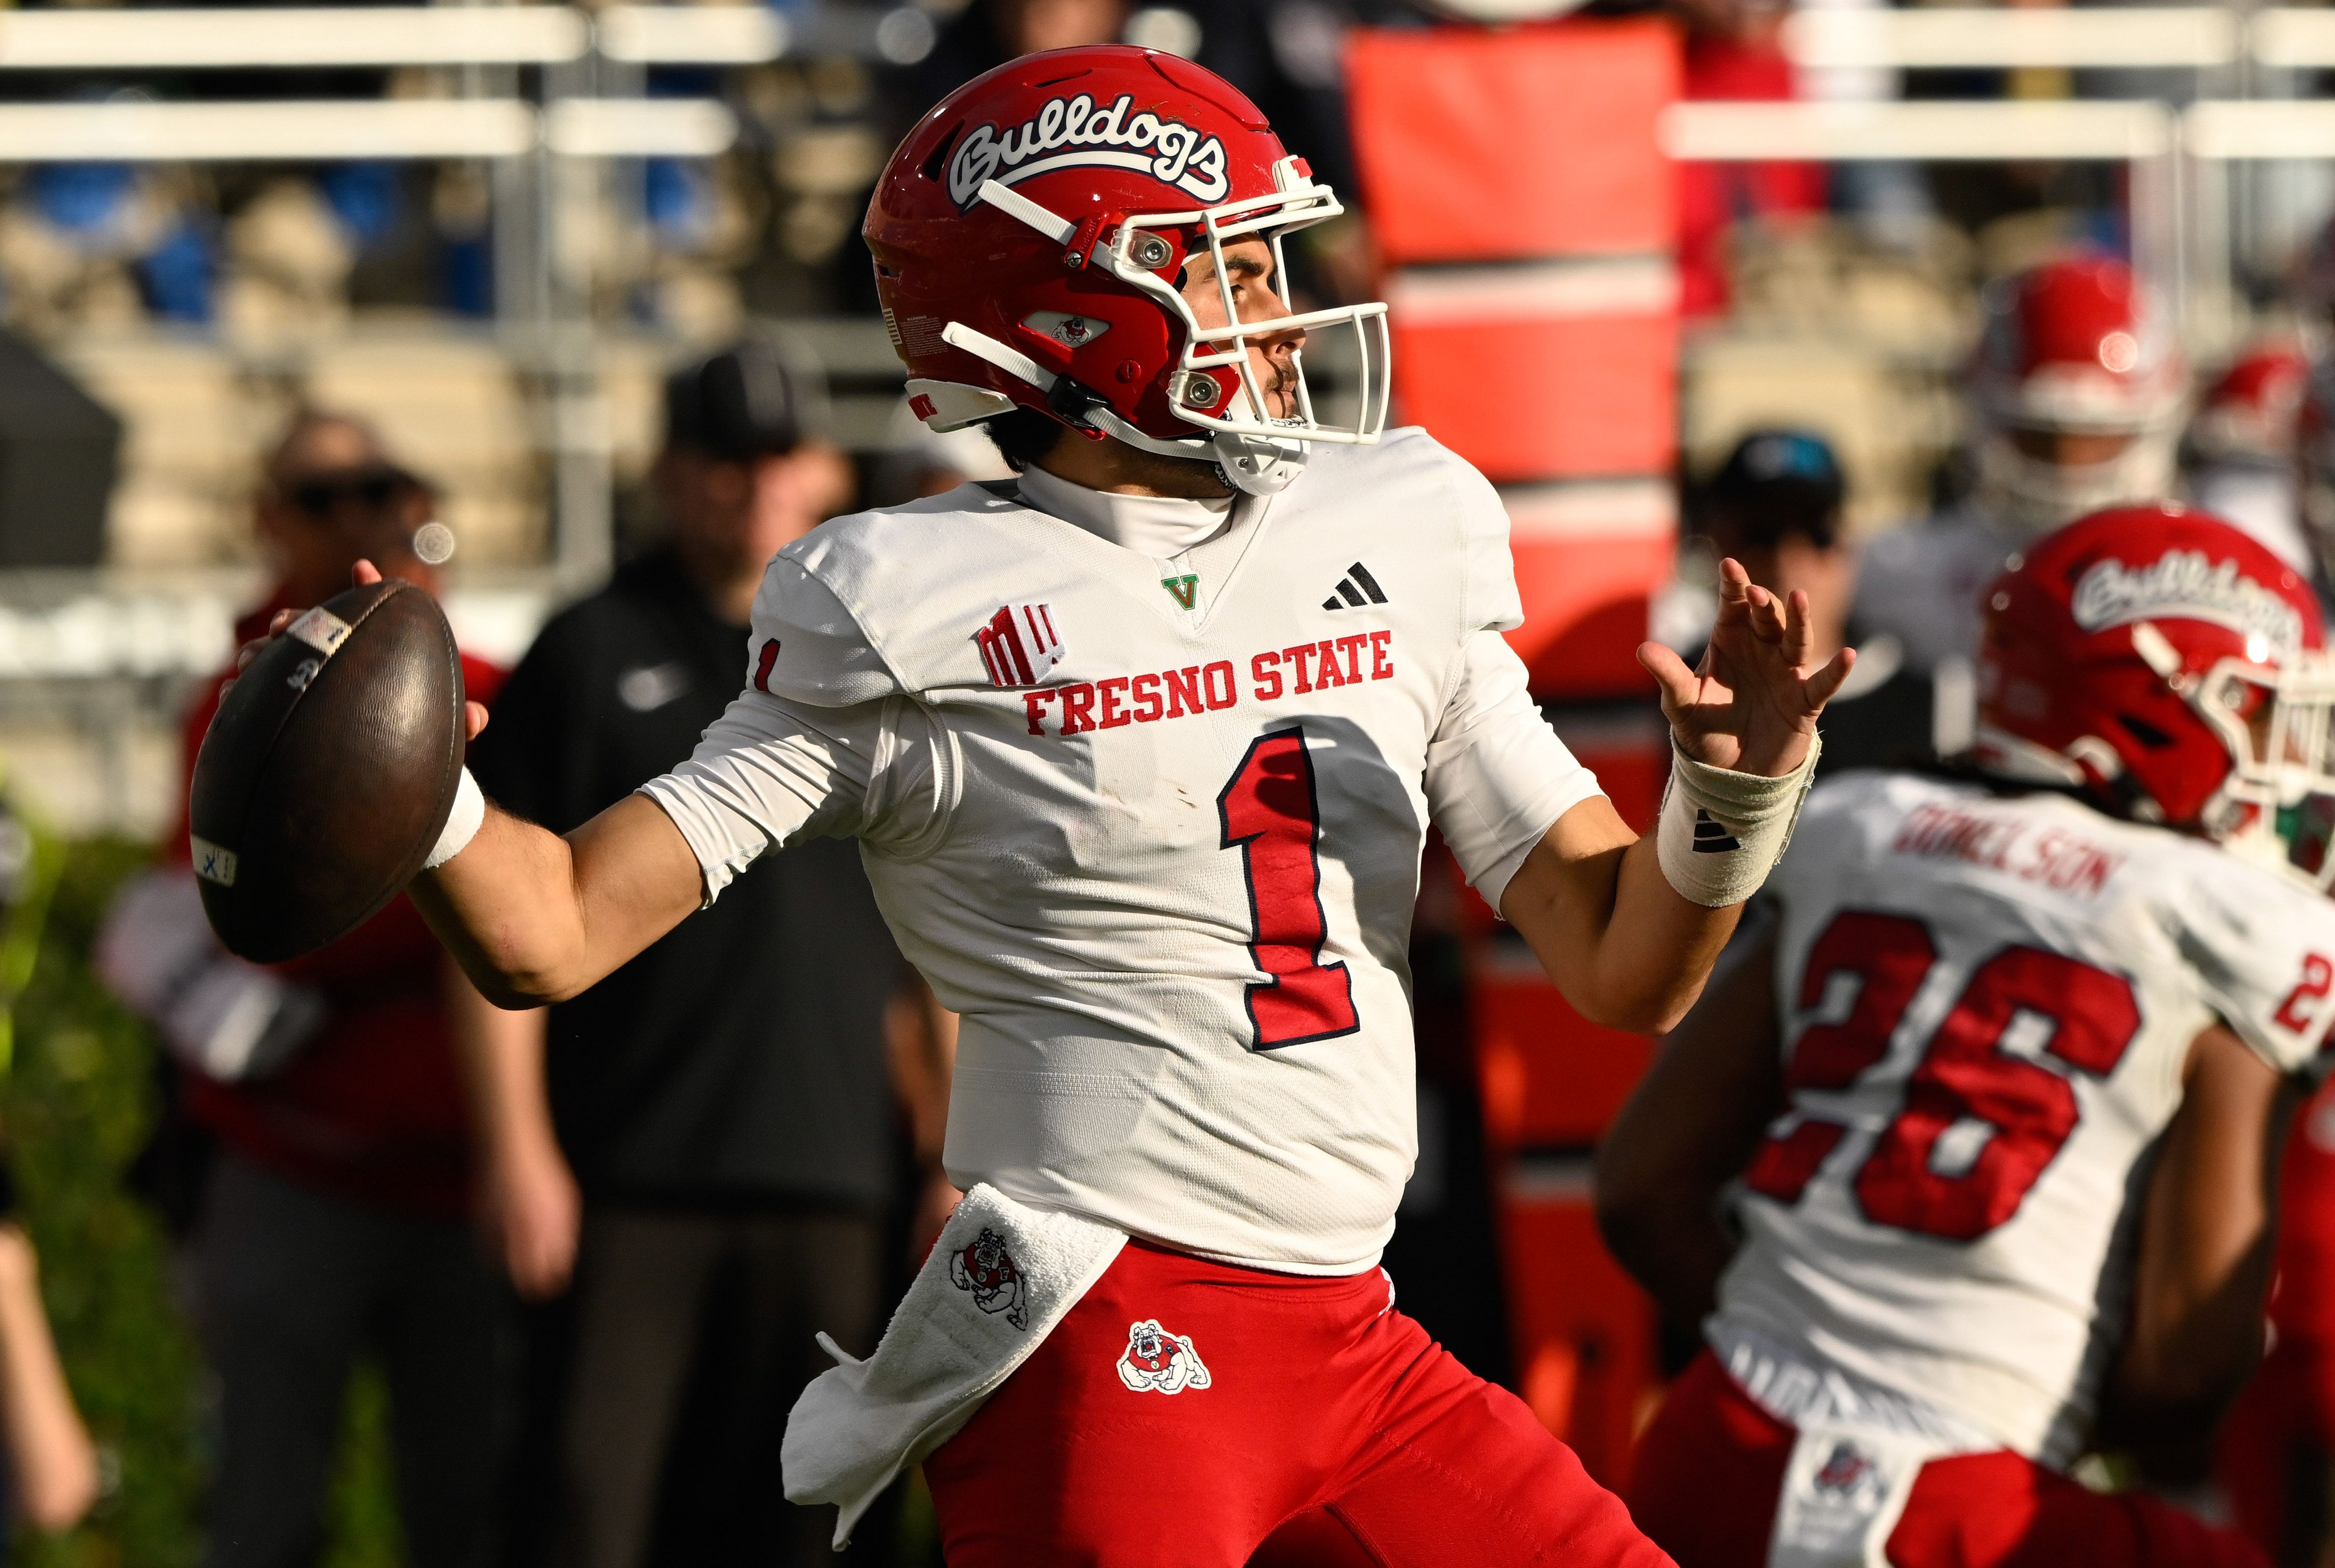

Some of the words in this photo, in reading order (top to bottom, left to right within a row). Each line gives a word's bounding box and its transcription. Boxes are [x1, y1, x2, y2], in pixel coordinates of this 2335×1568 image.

[948, 94, 1230, 206] Bulldogs
[1161, 574, 1199, 611] V
[1024, 660, 1237, 738] FRESNO
[1251, 630, 1393, 701] STATE
[1217, 726, 1361, 1051] 1
[1741, 908, 2142, 1243] 26
